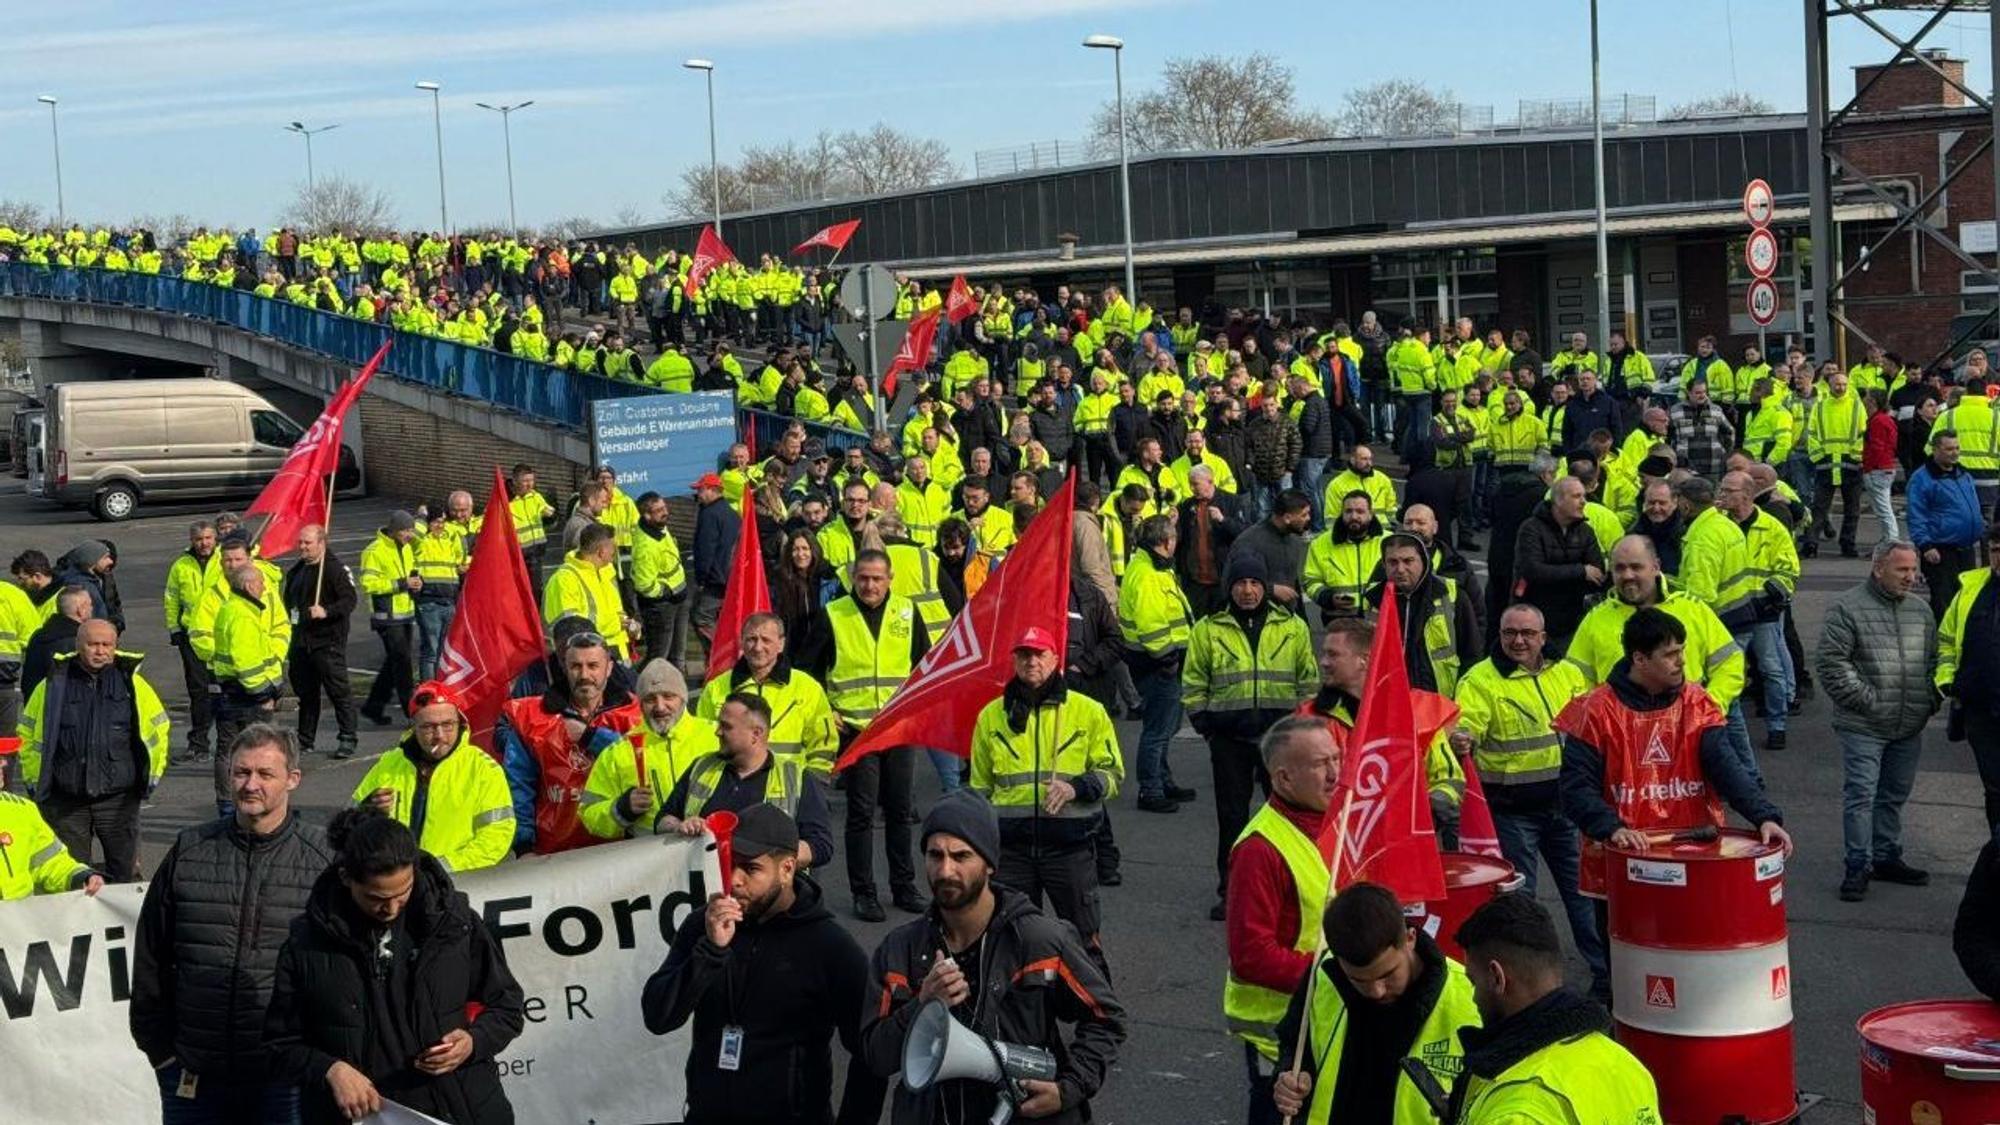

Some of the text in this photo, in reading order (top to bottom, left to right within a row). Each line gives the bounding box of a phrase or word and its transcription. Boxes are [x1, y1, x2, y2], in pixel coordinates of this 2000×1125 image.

[598, 408, 620, 422] Zoll
[624, 405, 673, 419] Customs
[598, 438, 669, 454] Versandlager
[615, 470, 648, 484] sfahrt
[0, 870, 707, 1020] Wi Ford
[523, 984, 594, 1023] e R
[497, 1055, 536, 1077] per
